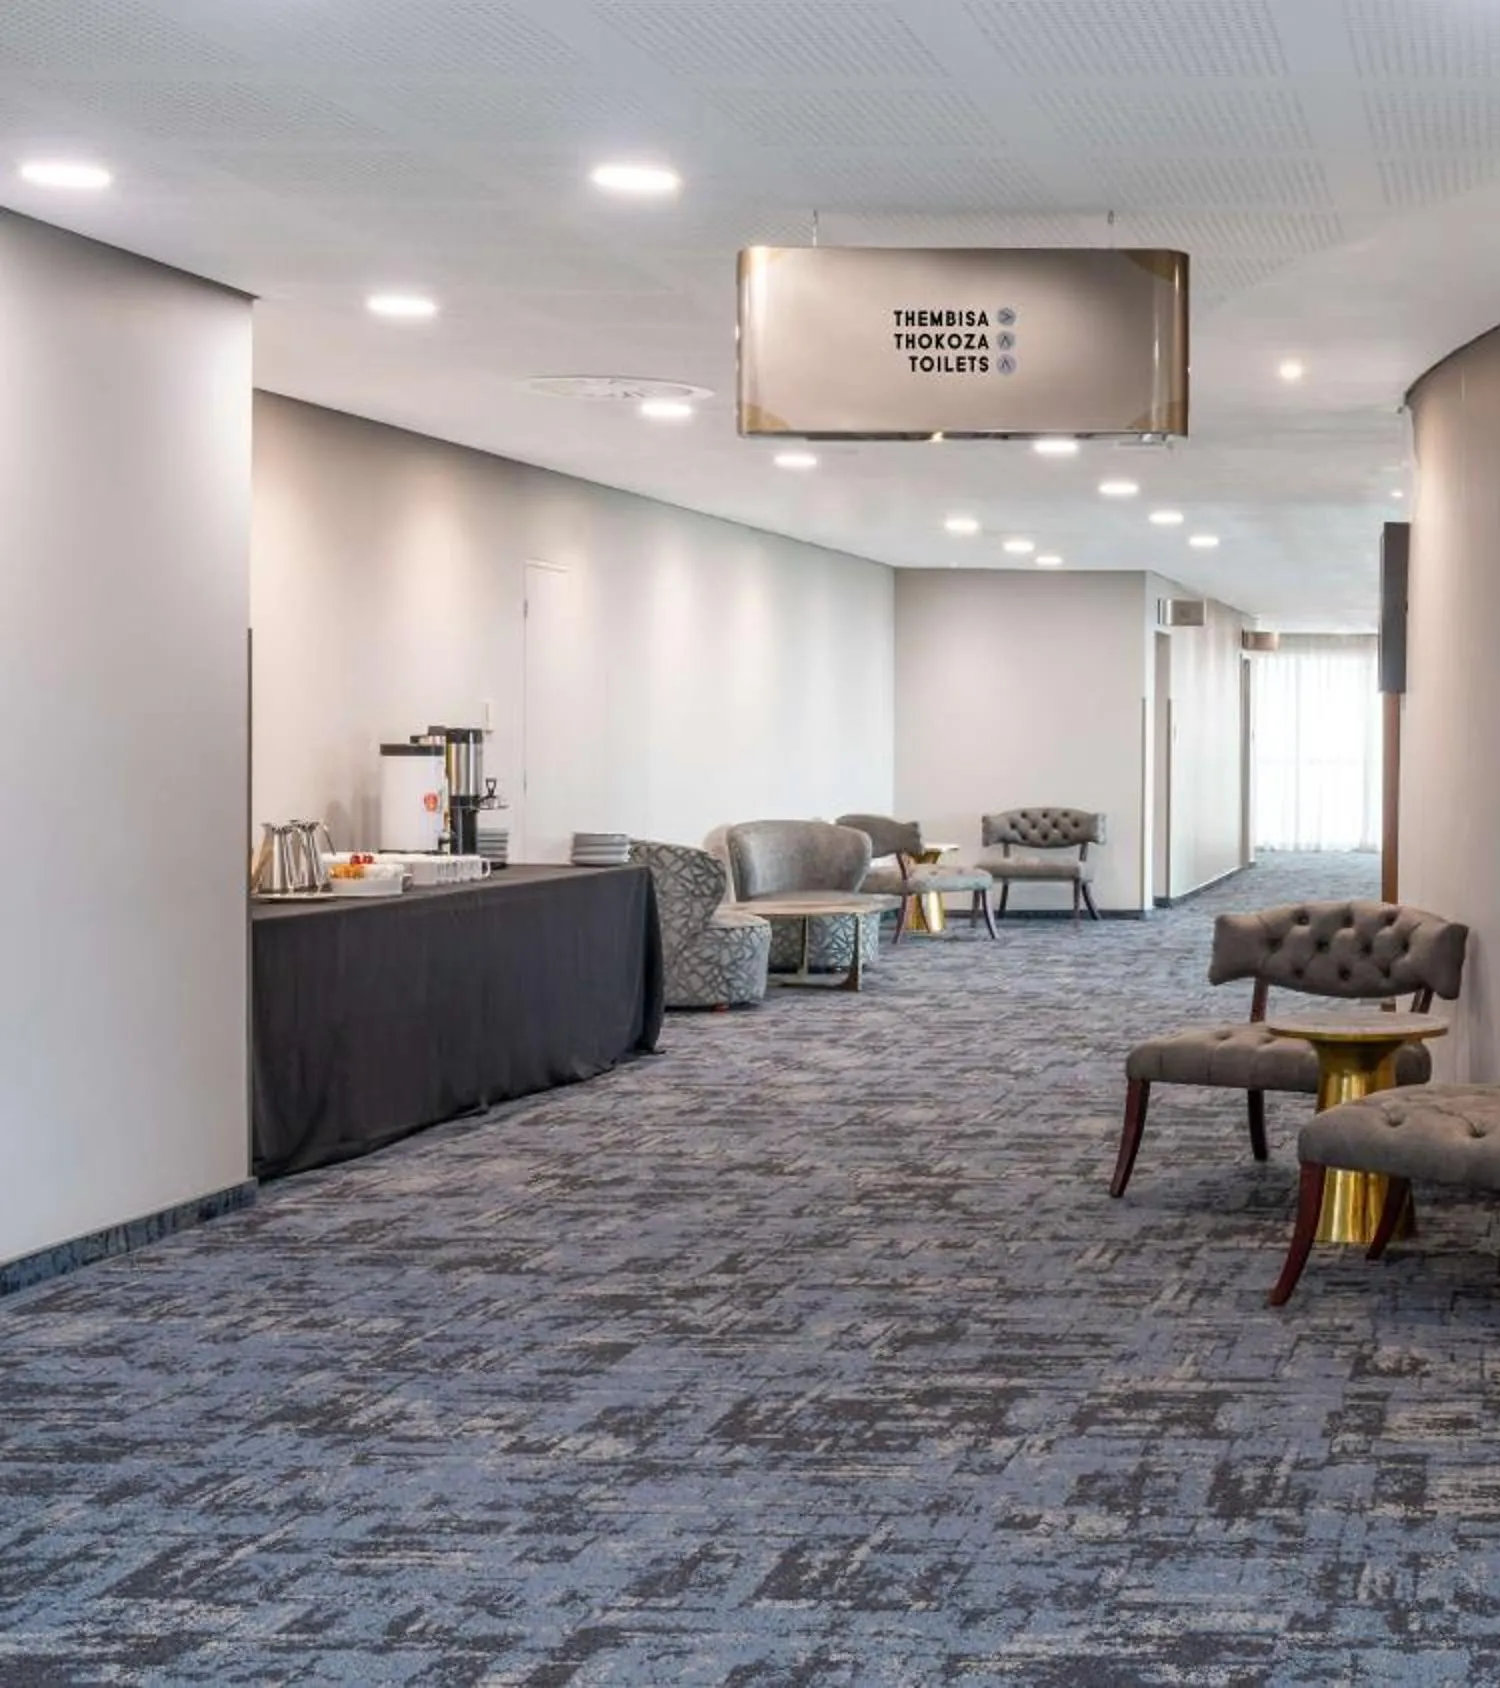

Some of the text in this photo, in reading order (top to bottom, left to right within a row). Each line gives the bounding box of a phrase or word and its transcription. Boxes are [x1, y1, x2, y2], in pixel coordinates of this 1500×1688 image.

[893, 310, 989, 327] THEMBISA
[894, 333, 990, 350] THOKOZA
[909, 355, 989, 373] TOILETS
